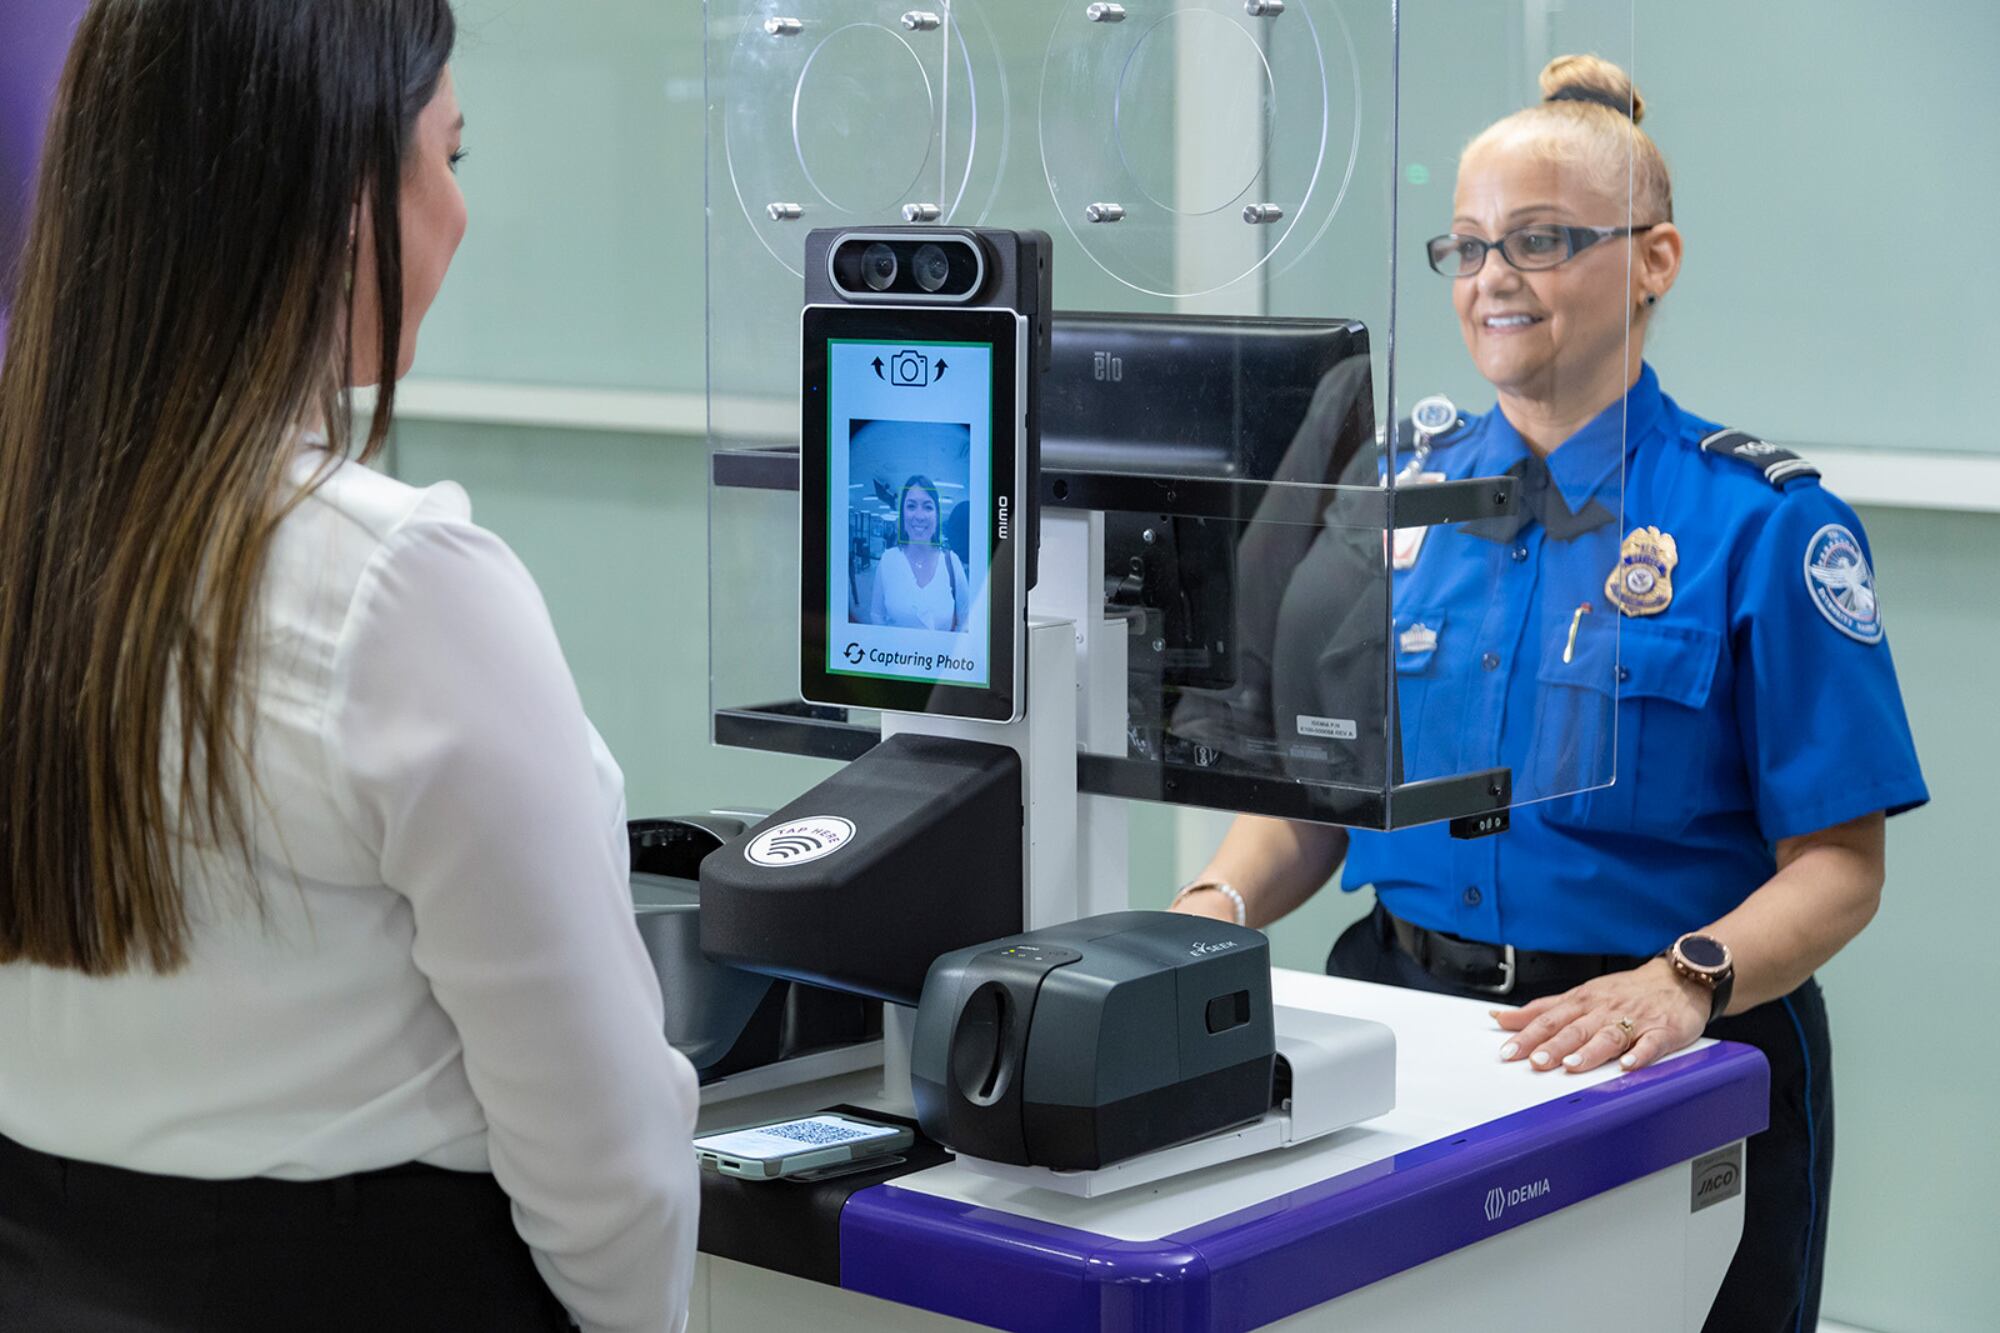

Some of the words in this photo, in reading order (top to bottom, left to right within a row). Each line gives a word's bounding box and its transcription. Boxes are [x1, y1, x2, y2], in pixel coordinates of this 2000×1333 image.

[998, 495, 1008, 539] mimo
[869, 648, 933, 671] Capturing
[936, 654, 975, 672] Photo
[778, 826, 808, 835] TAP
[811, 827, 840, 844] HERE
[1507, 1177, 1551, 1207] IDEMIA
[1697, 1170, 1733, 1196] JACO
